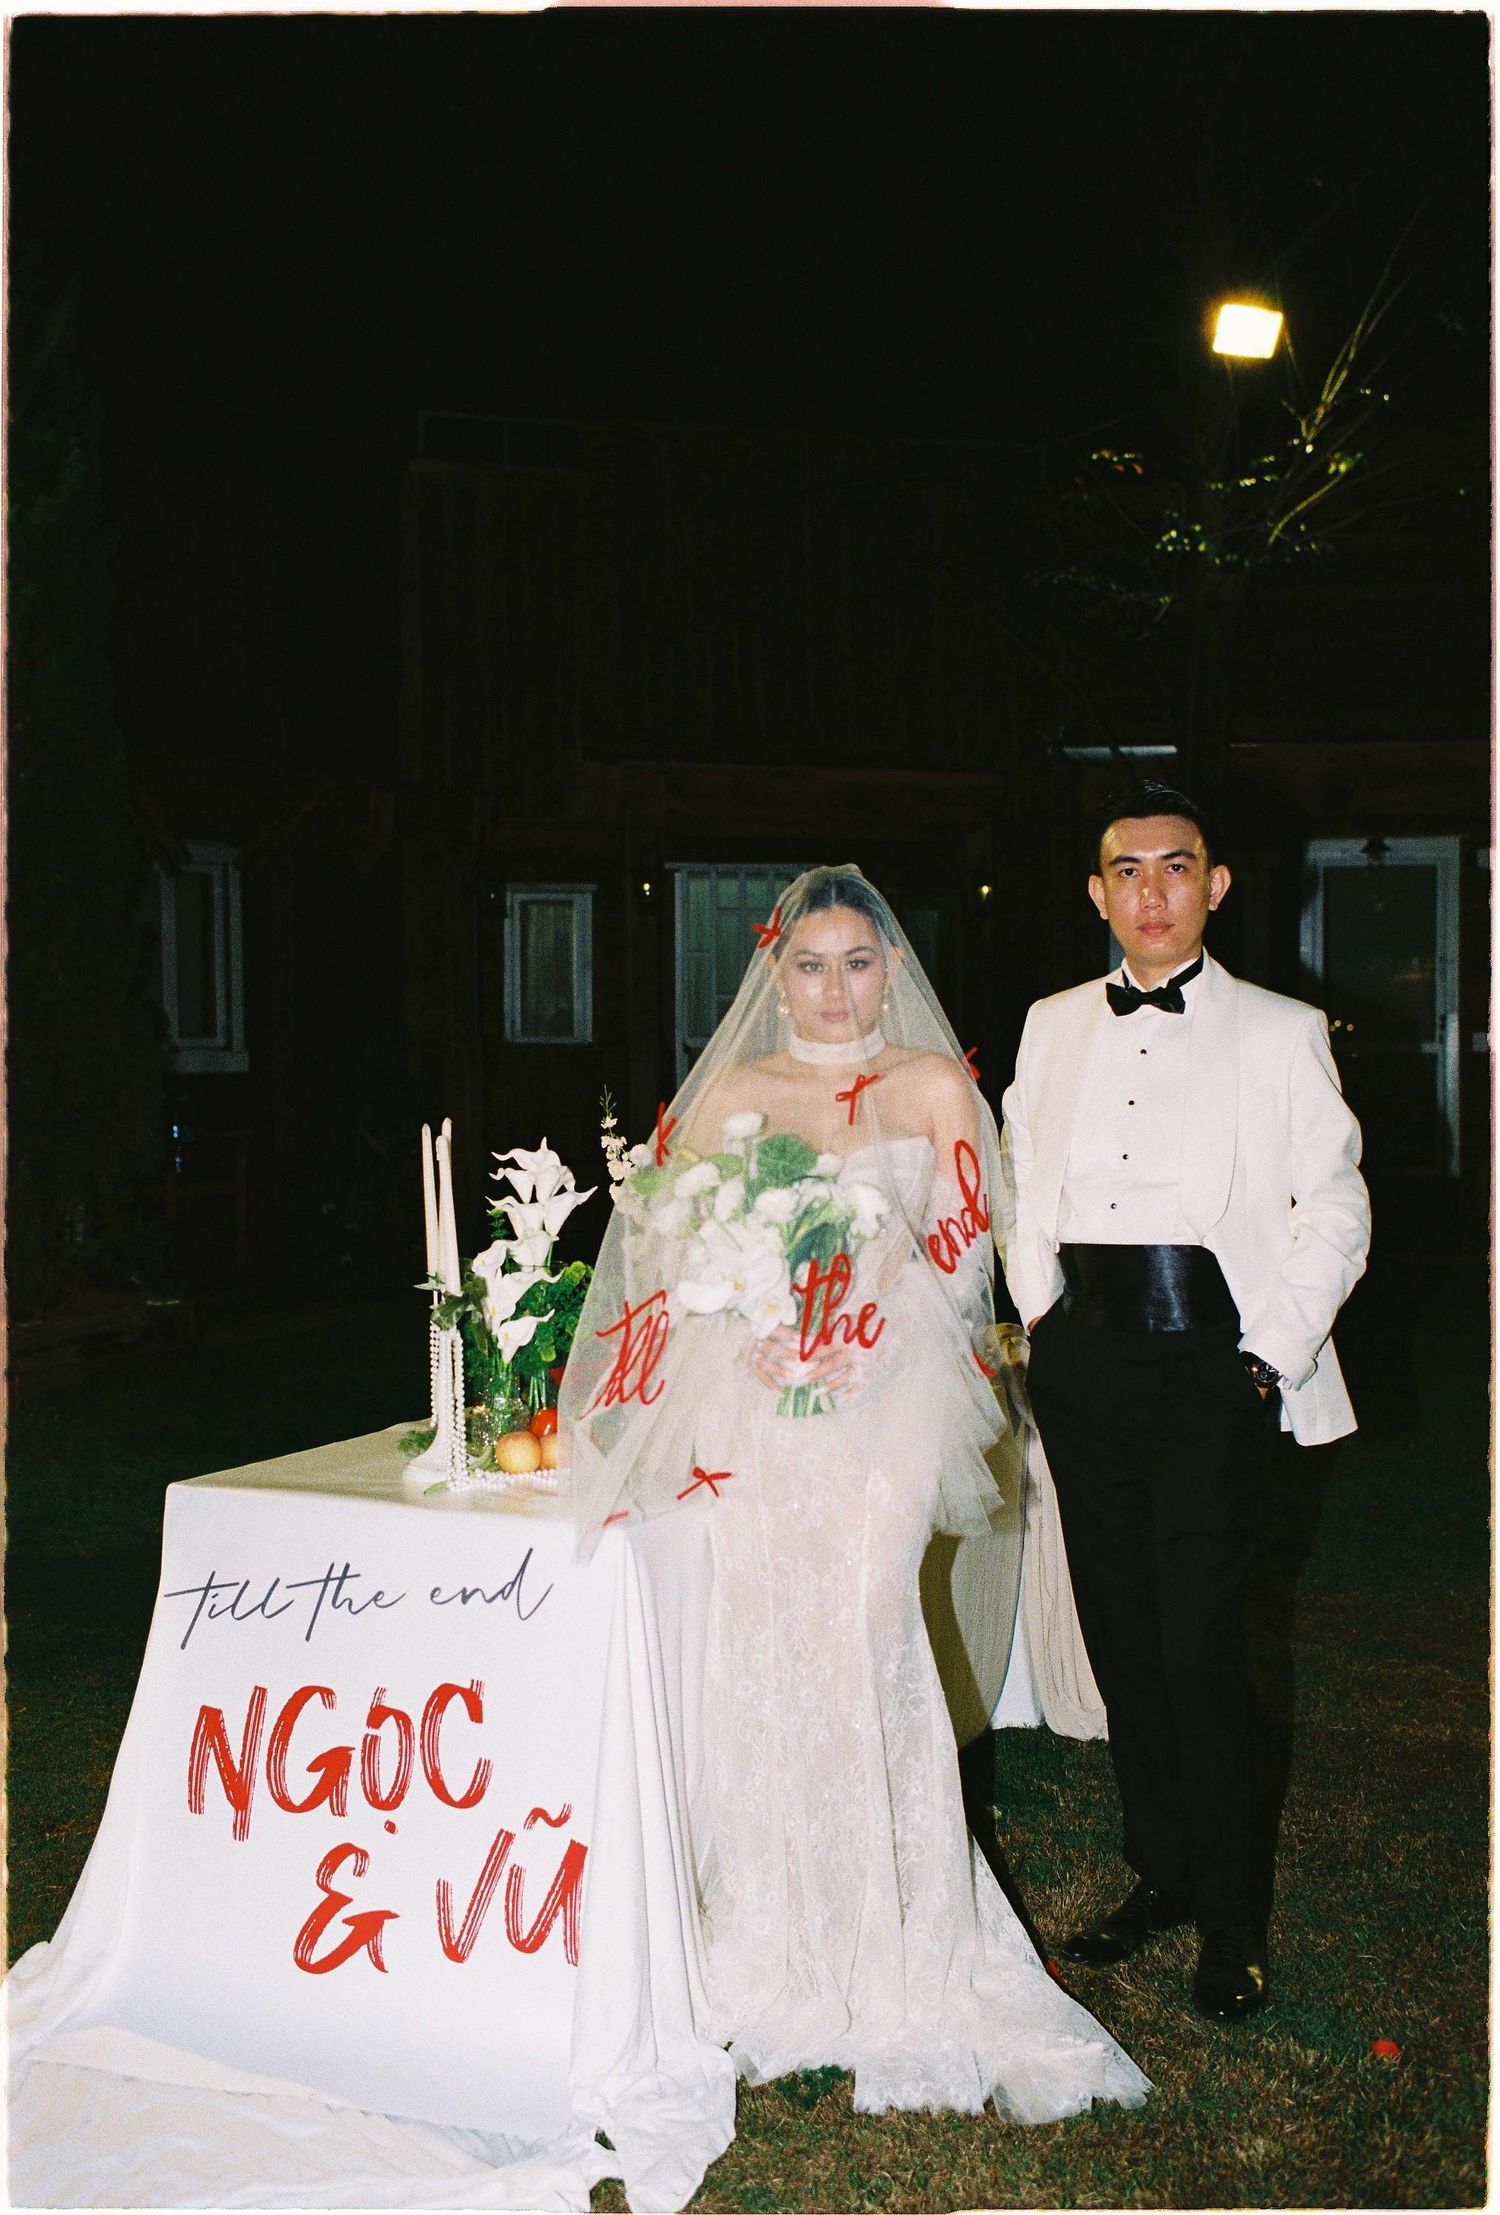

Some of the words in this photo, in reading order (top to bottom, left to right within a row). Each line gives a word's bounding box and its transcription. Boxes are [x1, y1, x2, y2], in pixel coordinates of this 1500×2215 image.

[792, 1252, 886, 1362] the
[926, 1138, 991, 1275] end
[164, 1570, 295, 1650] till
[286, 1562, 406, 1642] the
[430, 1547, 553, 1621] end
[187, 1679, 493, 1842] NGỌC
[293, 1842, 400, 1975] &
[435, 1802, 589, 1967] VŨ
